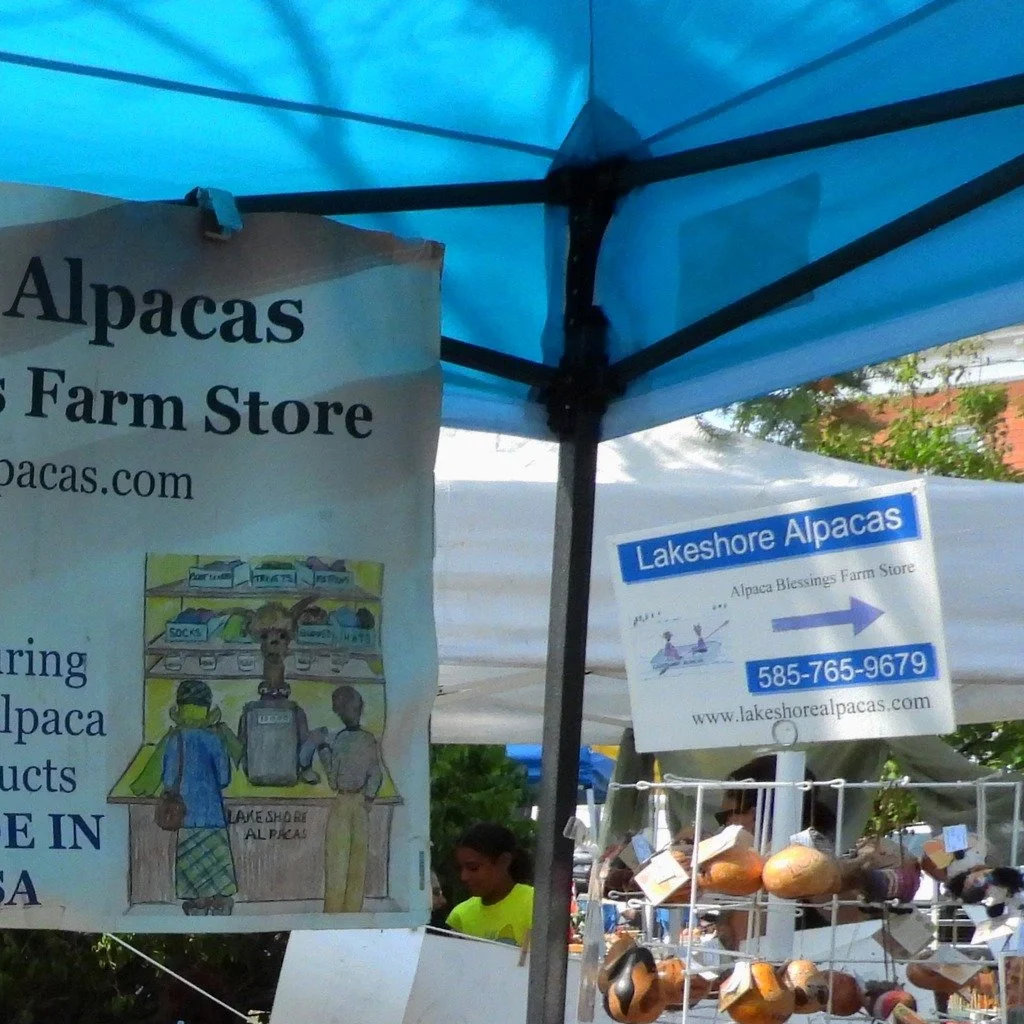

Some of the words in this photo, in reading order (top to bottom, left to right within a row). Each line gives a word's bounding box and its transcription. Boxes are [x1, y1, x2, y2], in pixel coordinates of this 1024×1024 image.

[2, 256, 305, 347] Alpacas
[24, 366, 186, 431] Farm
[204, 384, 373, 439] Store
[635, 529, 776, 571] Lakeshore
[784, 507, 903, 550] Alpacas
[730, 582, 773, 600] Alpaca
[776, 572, 837, 592] Blessings
[840, 568, 875, 583] Farm
[878, 561, 916, 577] Store
[169, 627, 202, 639] SOCKS
[758, 651, 928, 689] 585-765-9679
[692, 694, 932, 726] www.lakeshorealpacas.com
[48, 813, 105, 850] IN
